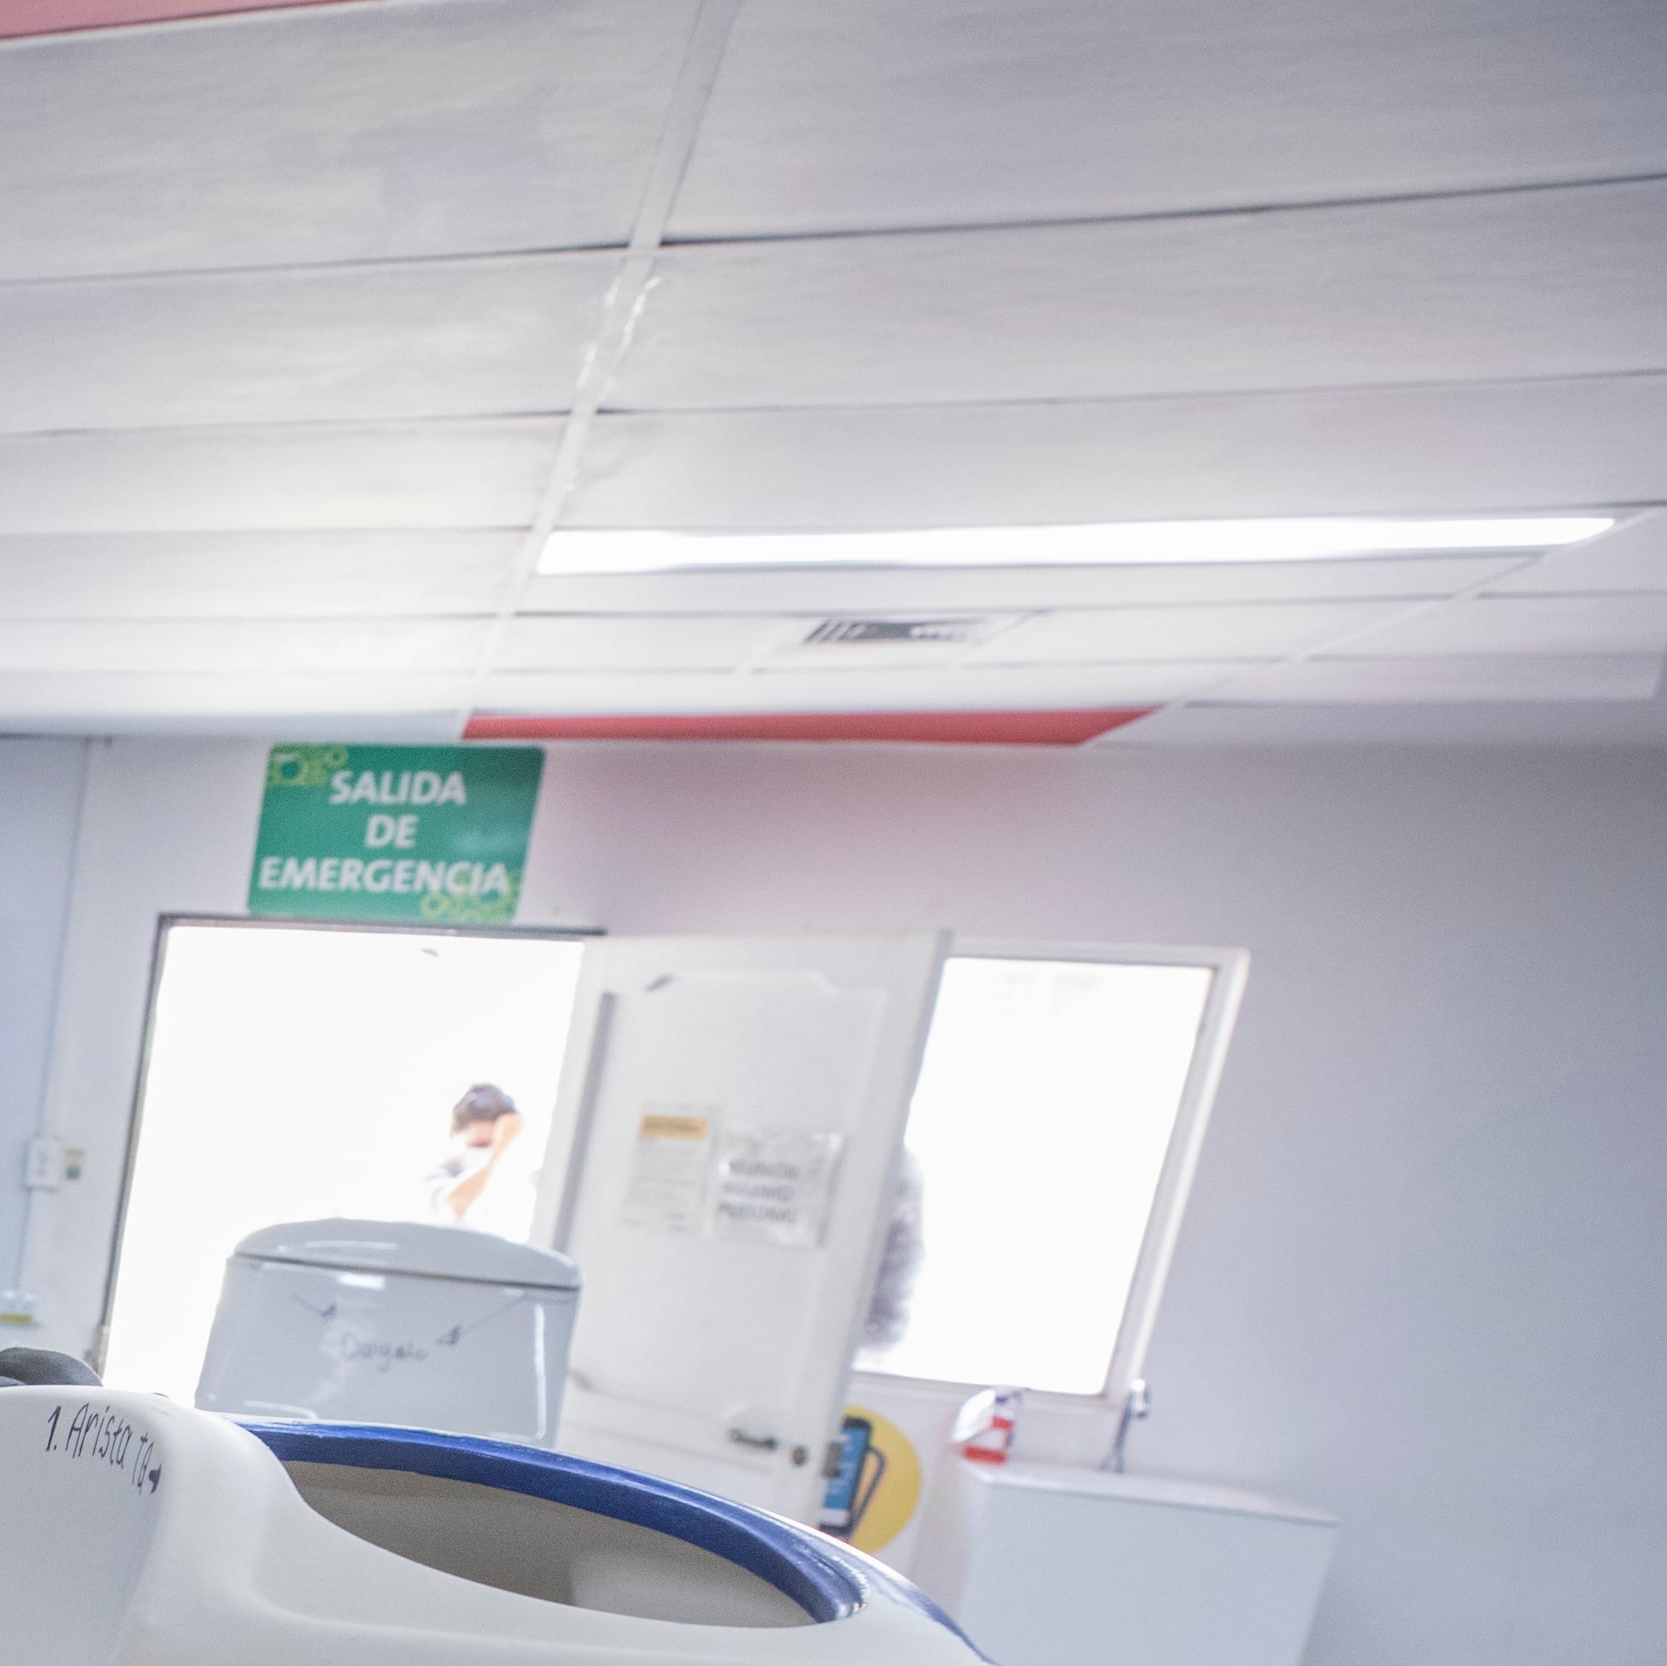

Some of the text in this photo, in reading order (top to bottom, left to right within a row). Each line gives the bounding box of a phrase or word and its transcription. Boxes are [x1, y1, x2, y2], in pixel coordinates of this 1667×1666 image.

[328, 769, 466, 806] SALIDA
[364, 814, 419, 849] DE
[258, 856, 509, 895] EMERGENCIA
[65, 1403, 133, 1469] Arista
